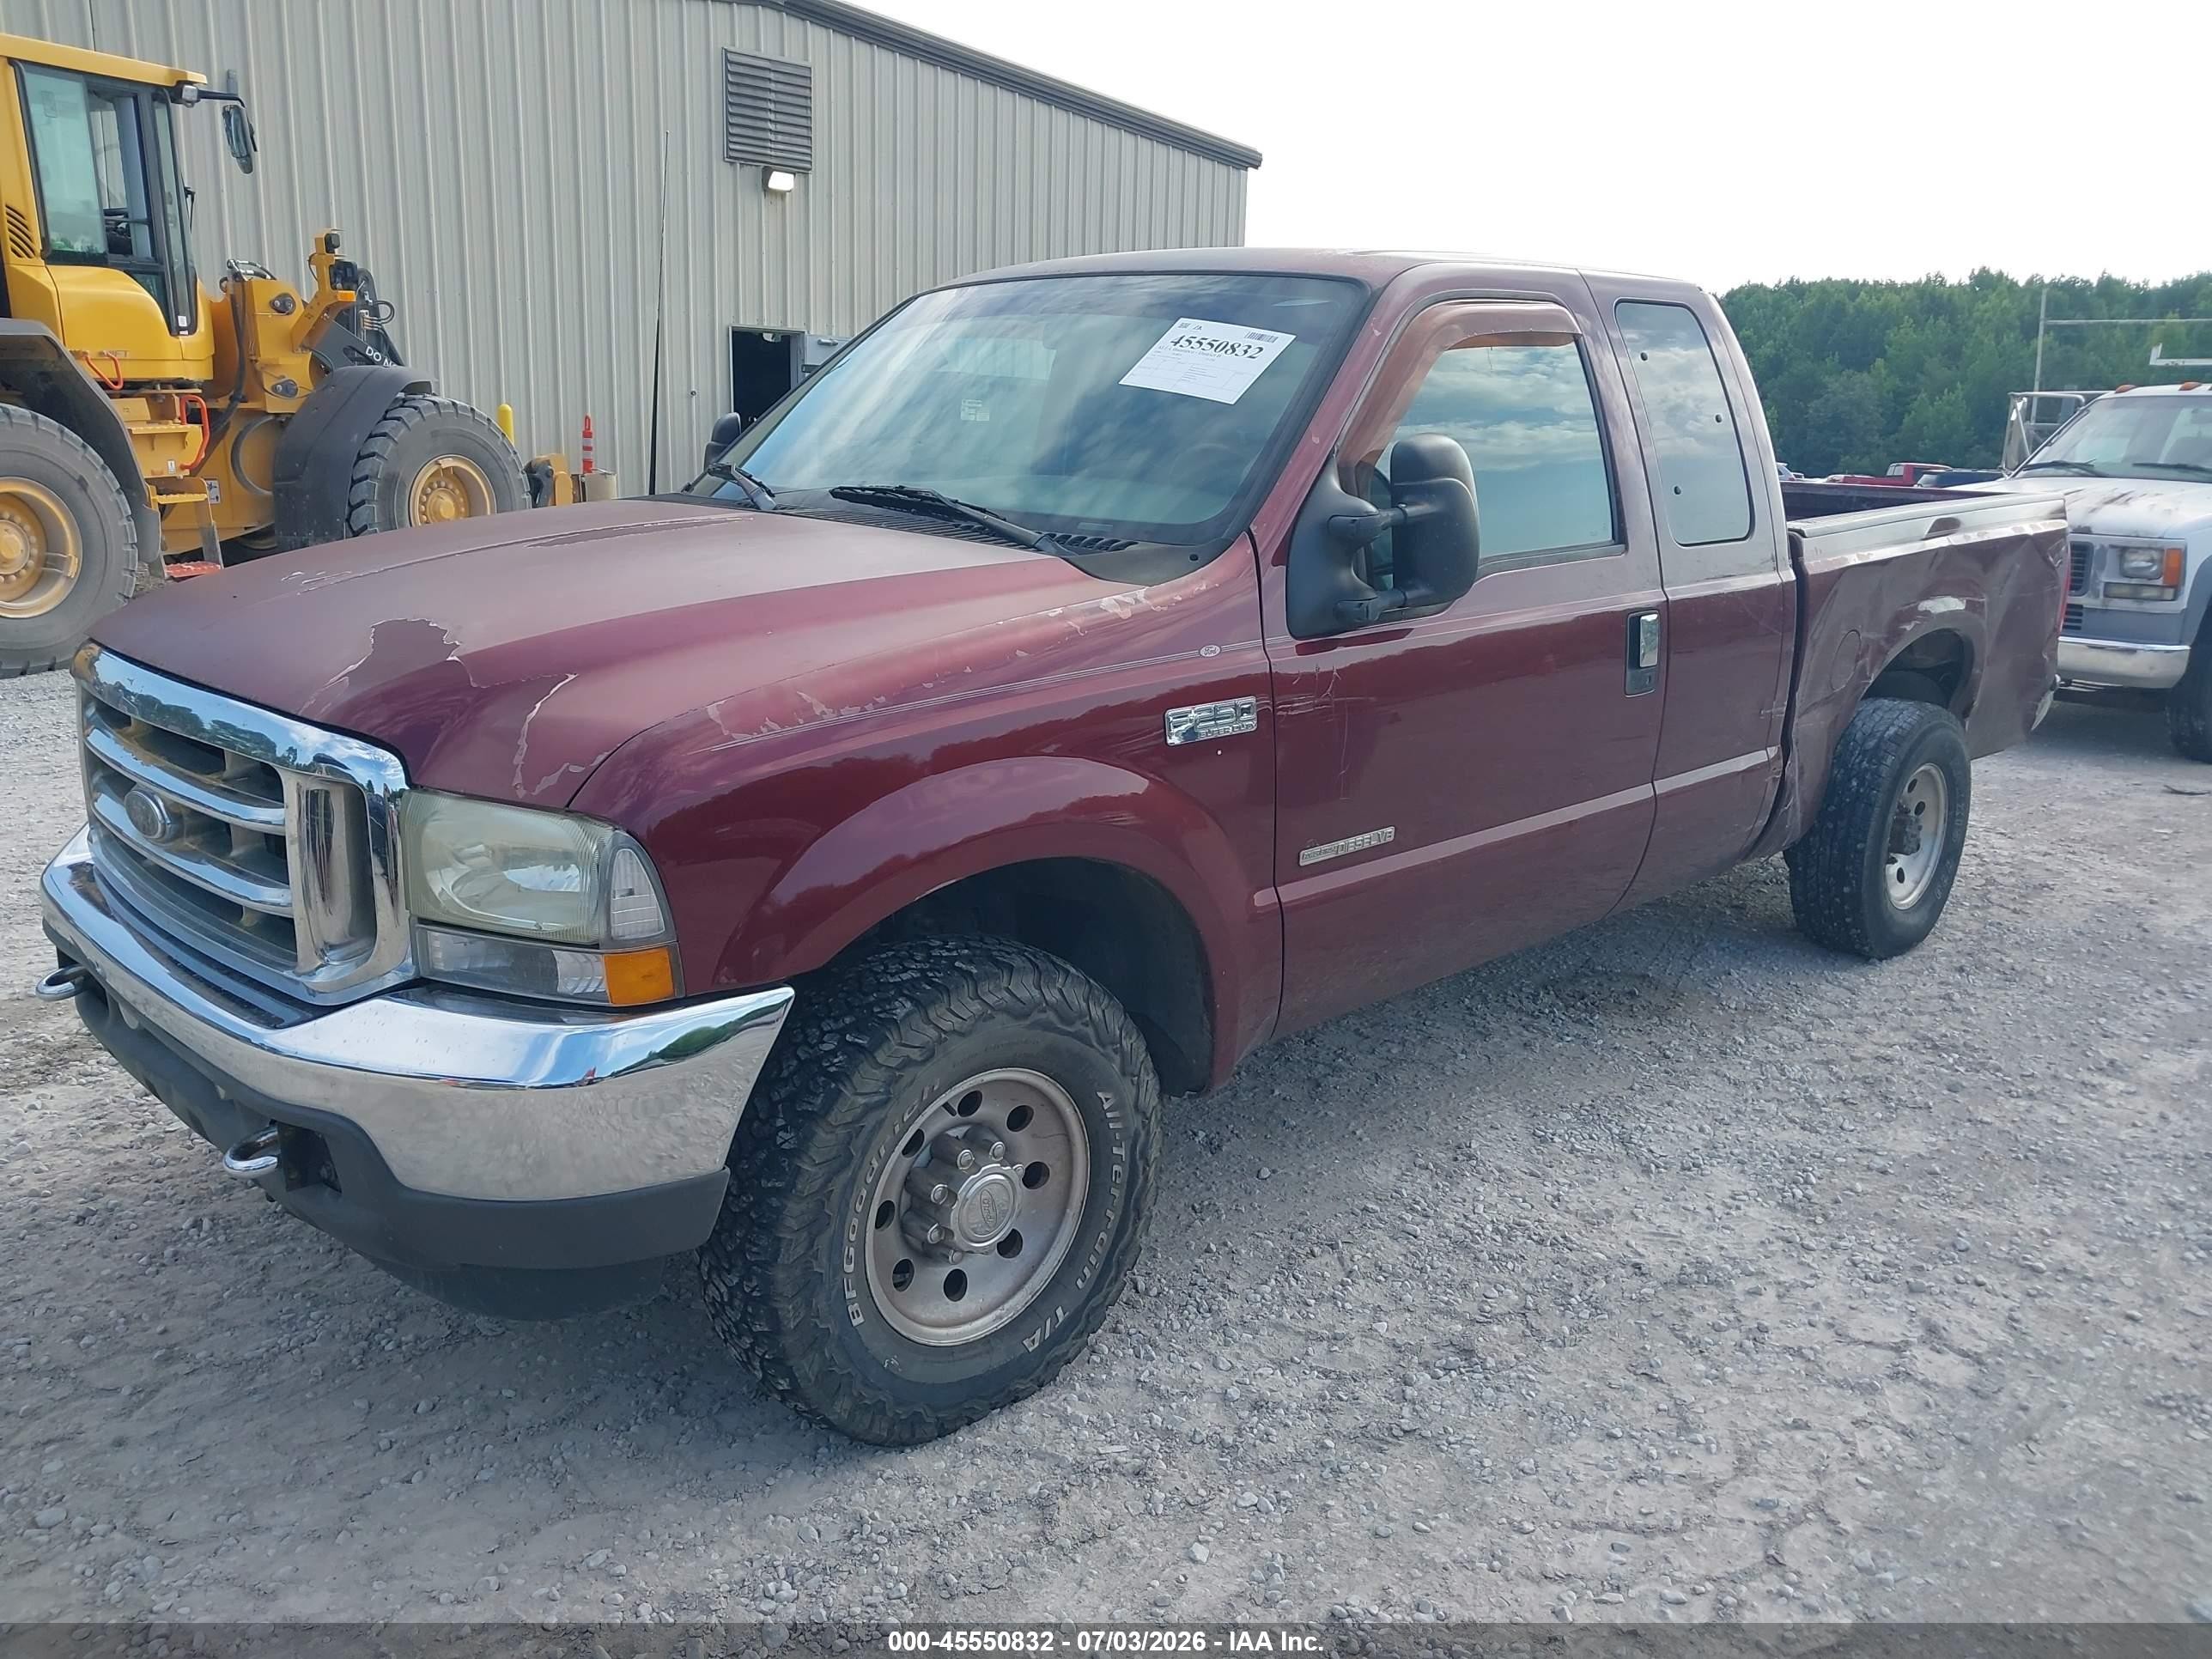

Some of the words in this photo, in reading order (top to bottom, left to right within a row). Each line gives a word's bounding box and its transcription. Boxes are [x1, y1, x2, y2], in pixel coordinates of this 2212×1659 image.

[366, 345, 382, 362] DO
[1170, 335, 1265, 360] 45550832
[1336, 833, 1379, 854] DIESEL
[1076, 1091, 1125, 1290] All-Terrain
[1022, 1305, 1070, 1353] T/A
